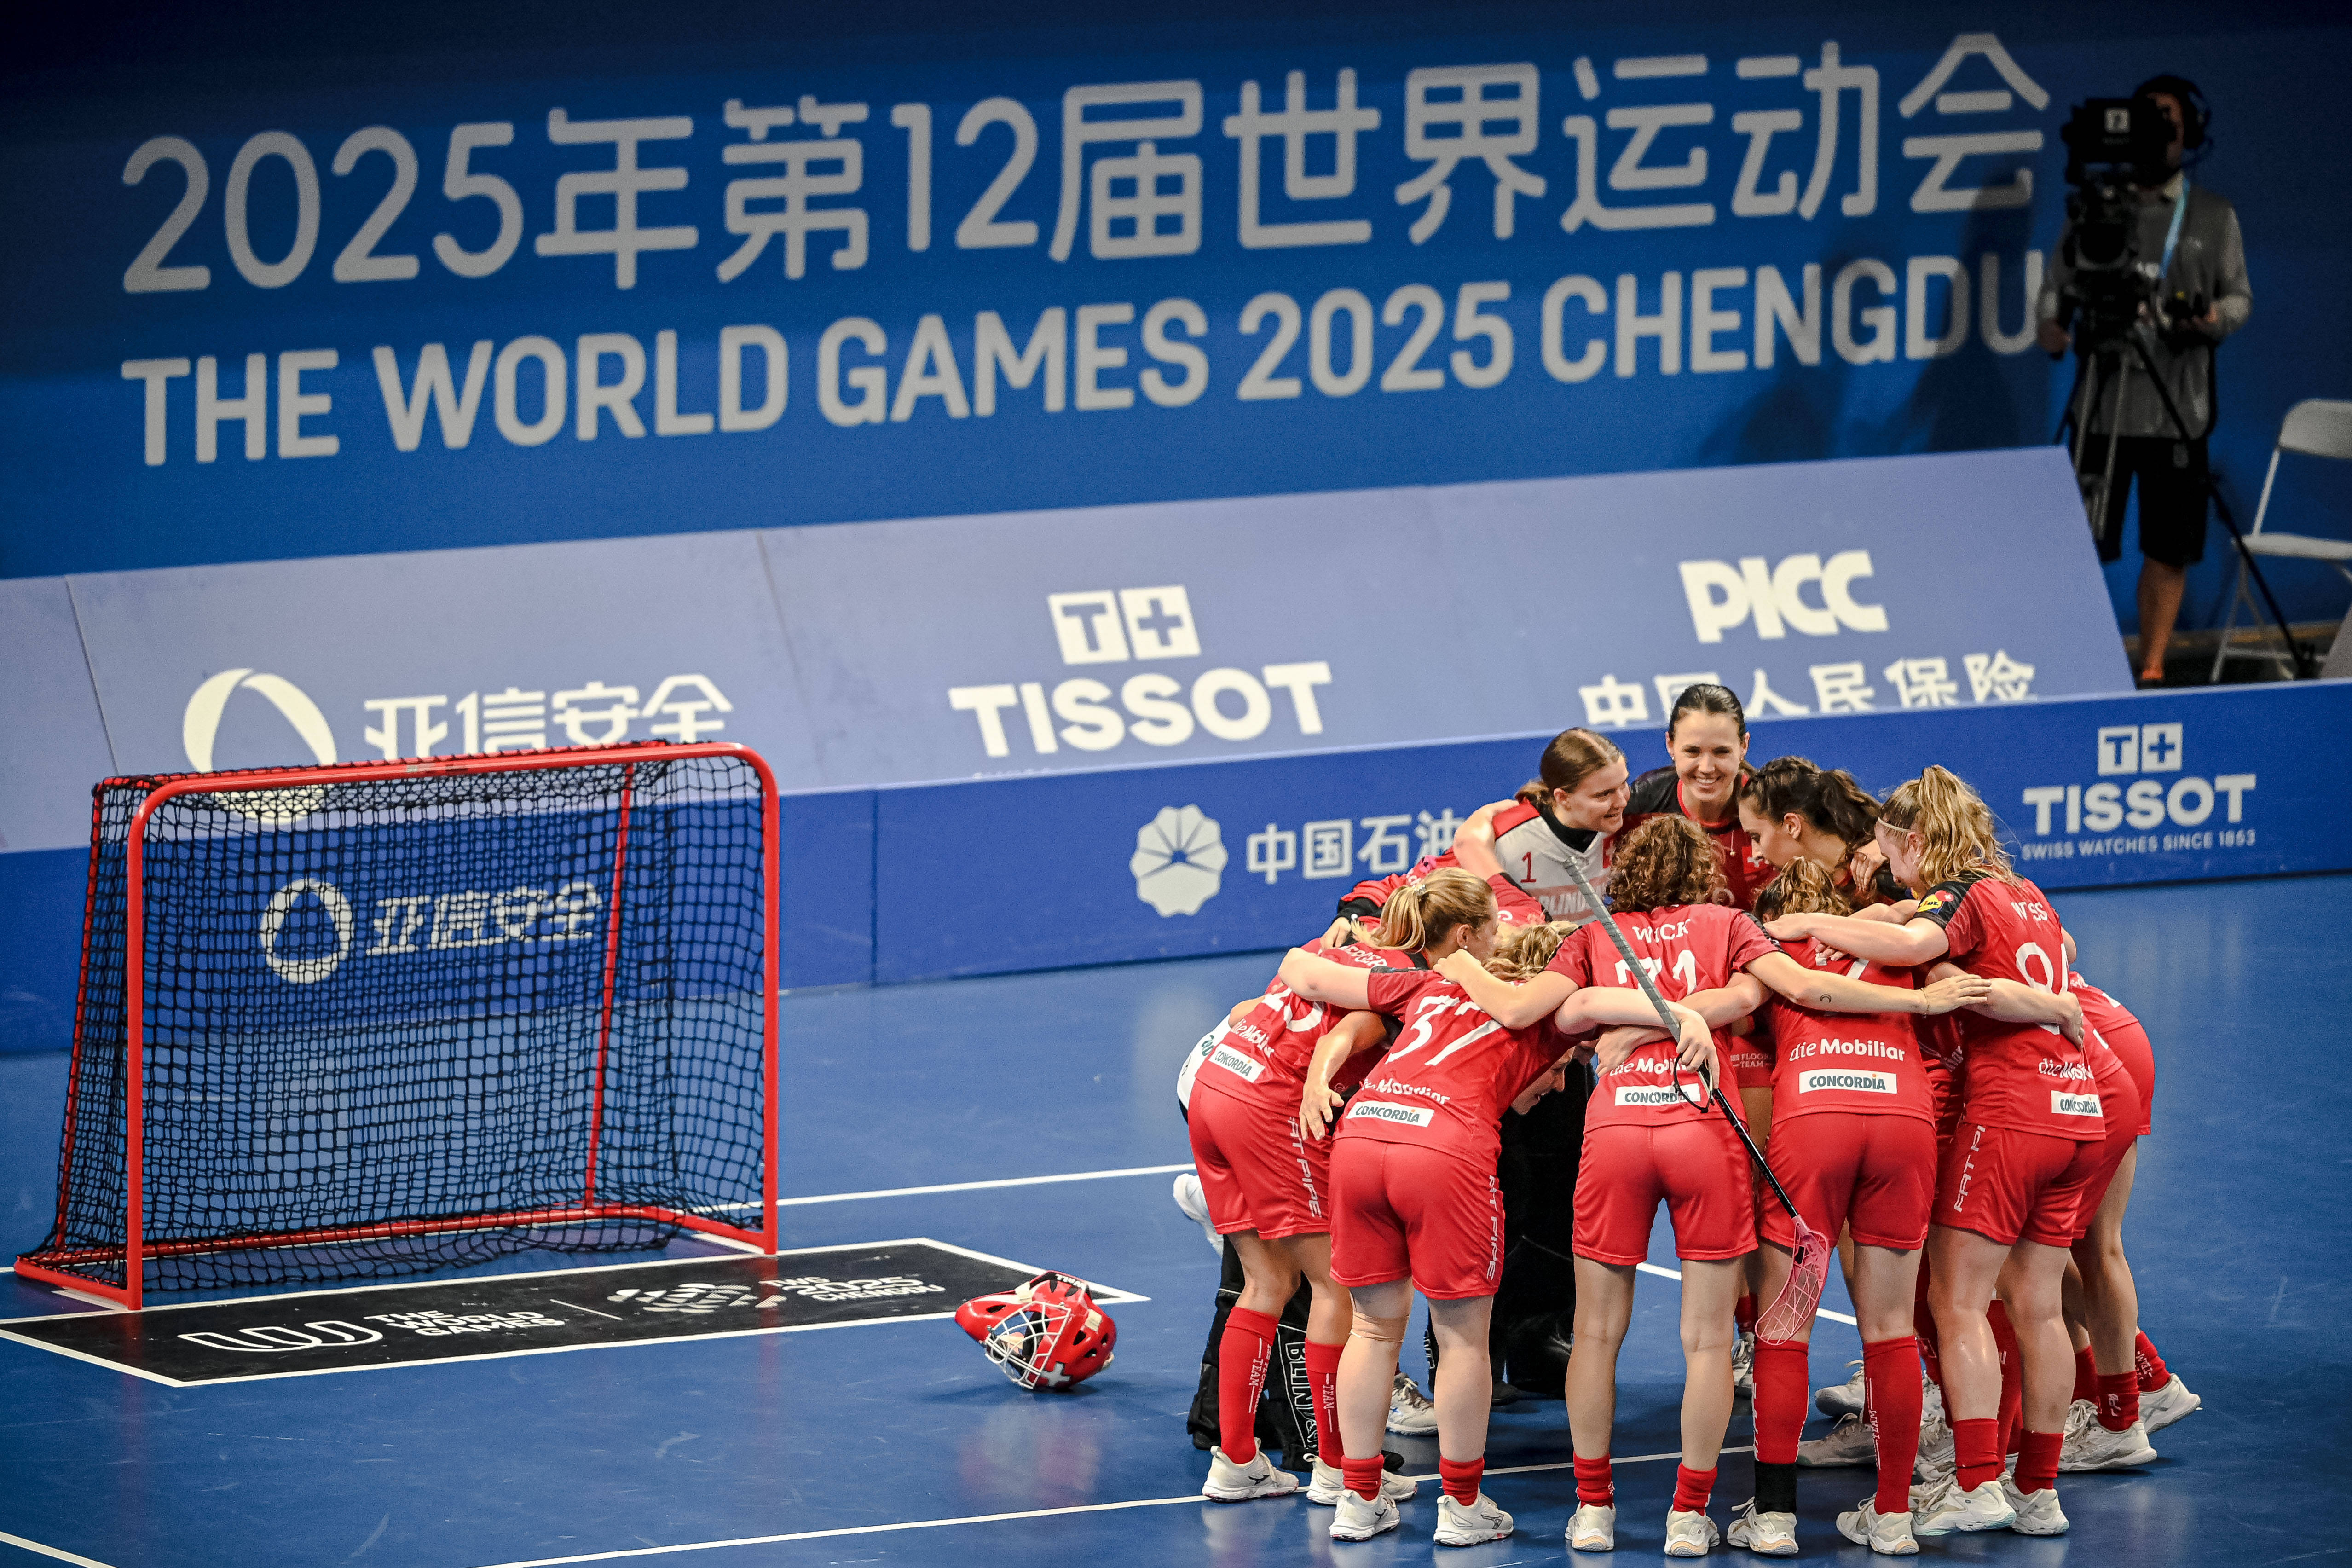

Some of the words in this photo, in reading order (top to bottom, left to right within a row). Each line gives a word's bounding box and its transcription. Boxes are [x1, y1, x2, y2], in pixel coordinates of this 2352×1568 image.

[122, 33, 2051, 295] 2025年第12届世界运动会
[121, 349, 340, 466] THE
[372, 324, 789, 451] WORLD
[817, 298, 1209, 427] GAMES
[1236, 281, 1514, 400] 2025
[1540, 250, 2044, 383] CHENGDU
[1679, 550, 1889, 643] PICC
[364, 674, 733, 759] 亚信安全
[948, 661, 1332, 757] TISSOT
[2023, 774, 2256, 836] TISSOT
[2079, 836, 2158, 856] WATCHES
[2163, 830, 2212, 851] SINCE
[1520, 851, 1537, 883] 1
[1632, 919, 1691, 943] WICK
[1214, 1050, 1253, 1077] CONCORDIA
[1789, 1041, 1817, 1062] die
[1820, 1038, 1906, 1061] Mobiliar
[2038, 1058, 2063, 1077] die
[1809, 1074, 1886, 1091] CONCORDIA
[1355, 1106, 1420, 1123] CONCORDIA
[1971, 1125, 1986, 1152] PI
[1296, 1158, 1322, 1218] PIPE
[1486, 1216, 1498, 1281] PIPE
[782, 1276, 924, 1296] 2025
[363, 1310, 455, 1323] THE
[386, 1311, 545, 1329] WORLD
[414, 1319, 566, 1336] GAMES
[1249, 1358, 1264, 1387] TEAM
[1322, 1384, 1334, 1410] TEAM
[1869, 1409, 1880, 1440] TEAM
